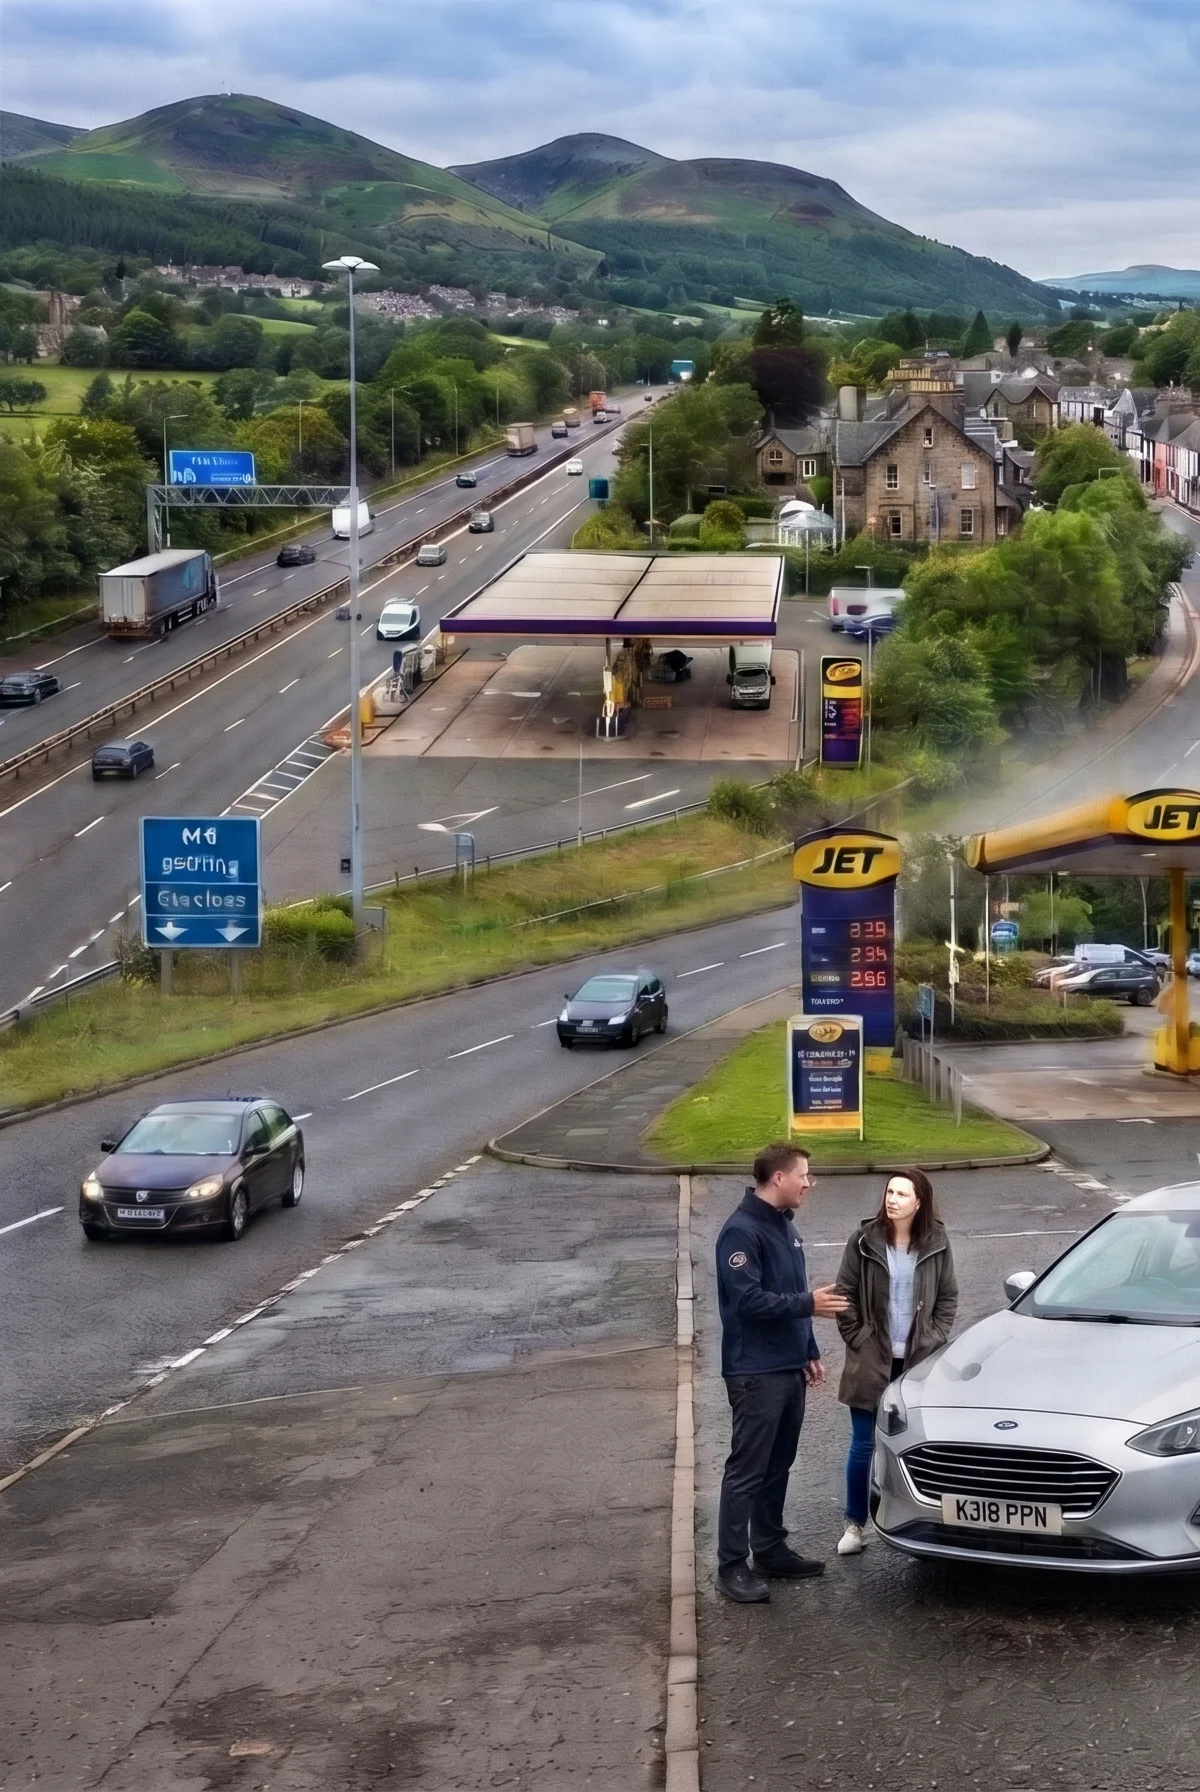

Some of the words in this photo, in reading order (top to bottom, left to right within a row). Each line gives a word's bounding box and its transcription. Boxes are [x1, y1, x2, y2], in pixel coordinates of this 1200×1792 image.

[812, 847, 885, 874] JET
[956, 1499, 1000, 1523] K318
[1006, 1503, 1047, 1528] PPN
